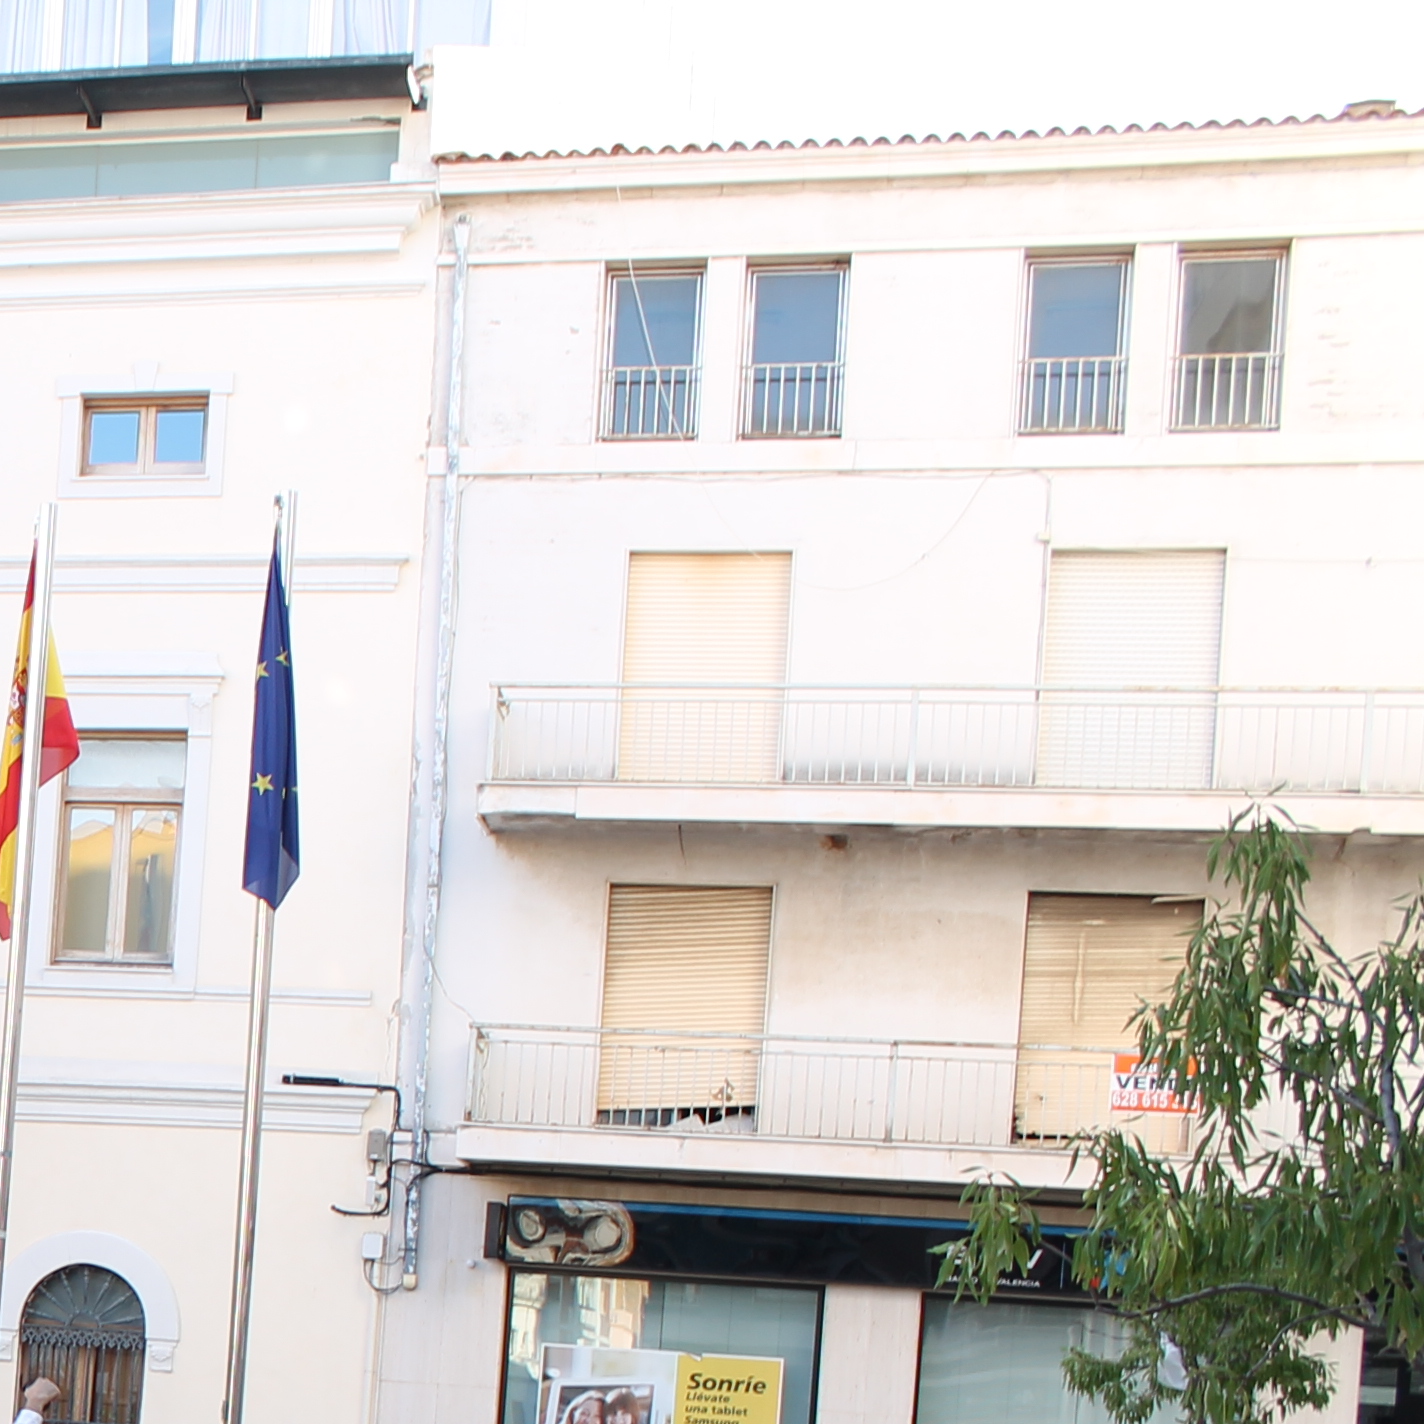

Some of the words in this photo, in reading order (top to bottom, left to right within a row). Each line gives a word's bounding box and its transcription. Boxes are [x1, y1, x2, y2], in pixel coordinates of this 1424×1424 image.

[1113, 1090, 1138, 1108] 628
[686, 1372, 767, 1395] Sonríe
[686, 1391, 730, 1404] Llévate
[684, 1405, 708, 1414] una
[712, 1405, 748, 1417] tablet
